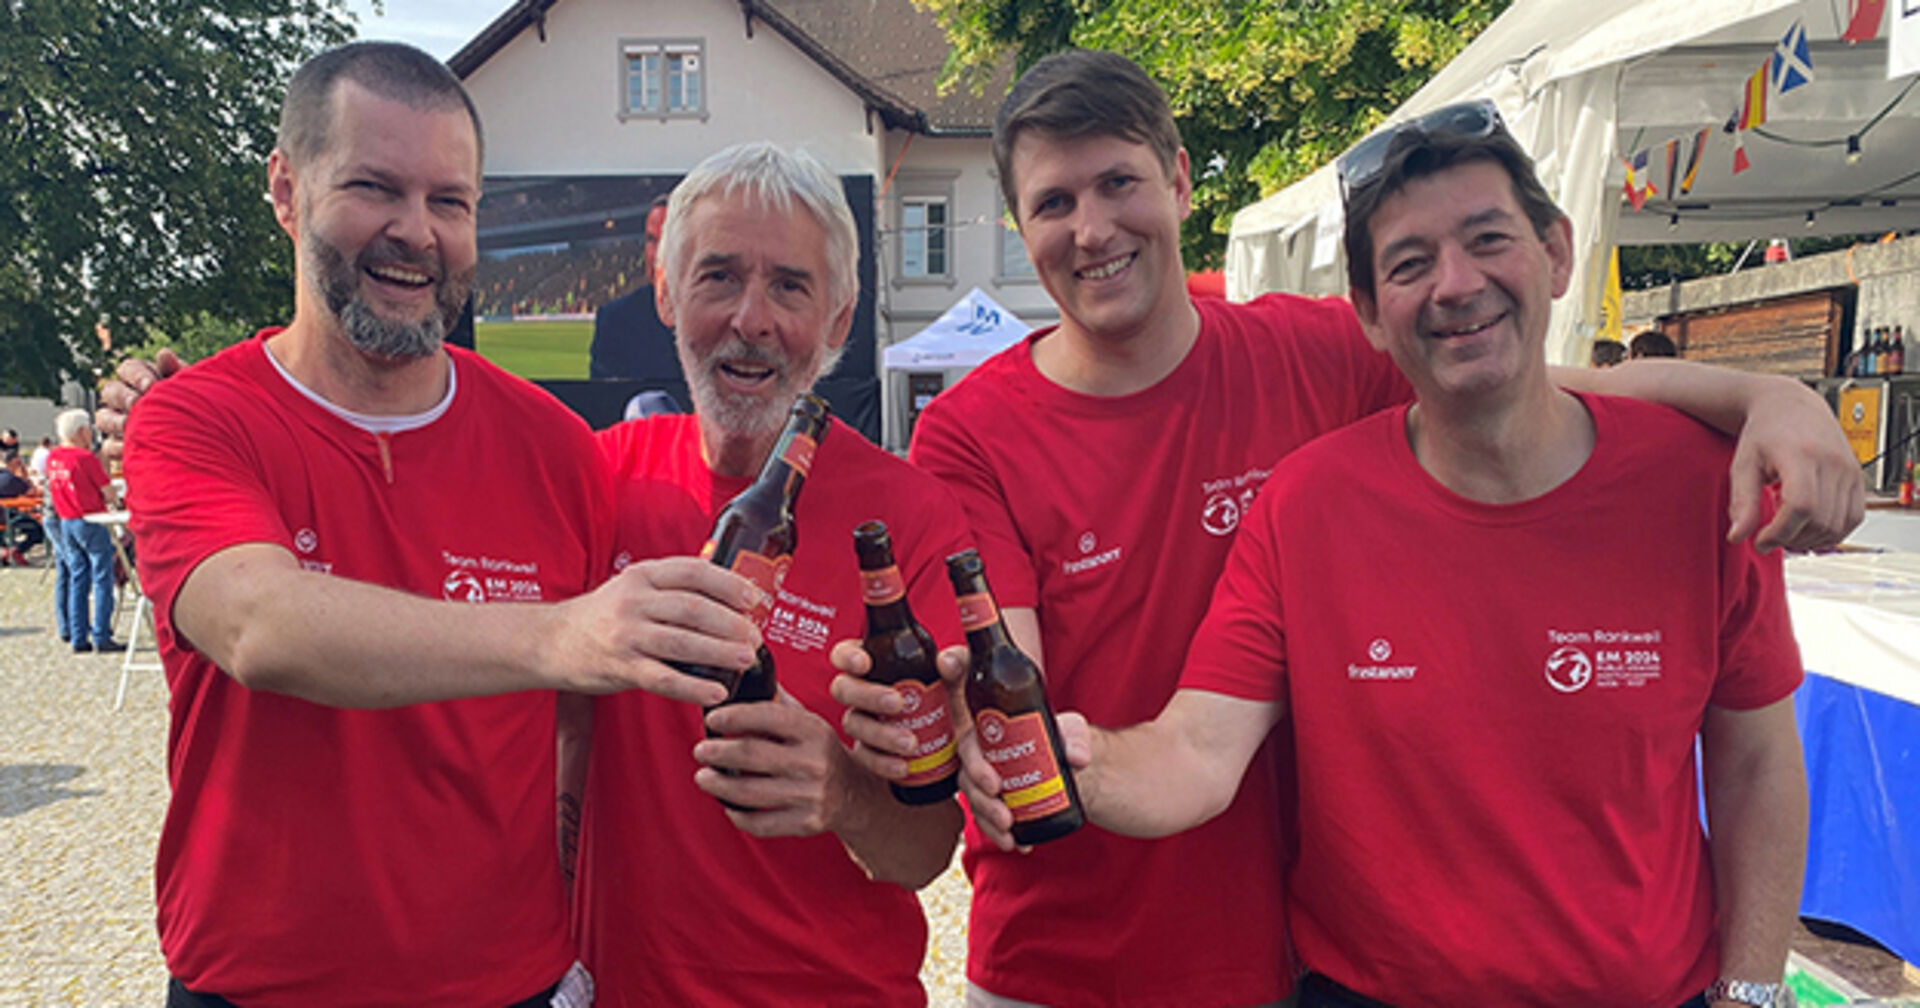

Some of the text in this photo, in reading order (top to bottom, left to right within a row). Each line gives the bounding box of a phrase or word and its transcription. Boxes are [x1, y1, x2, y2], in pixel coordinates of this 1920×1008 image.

[1203, 479, 1232, 494] Team
[442, 550, 477, 568] Team
[485, 577, 540, 594] EM 2024
[773, 607, 794, 622] EM
[797, 616, 830, 636] 2024
[1548, 629, 1660, 643] Team Rankweil
[1596, 650, 1660, 664] EM 2024
